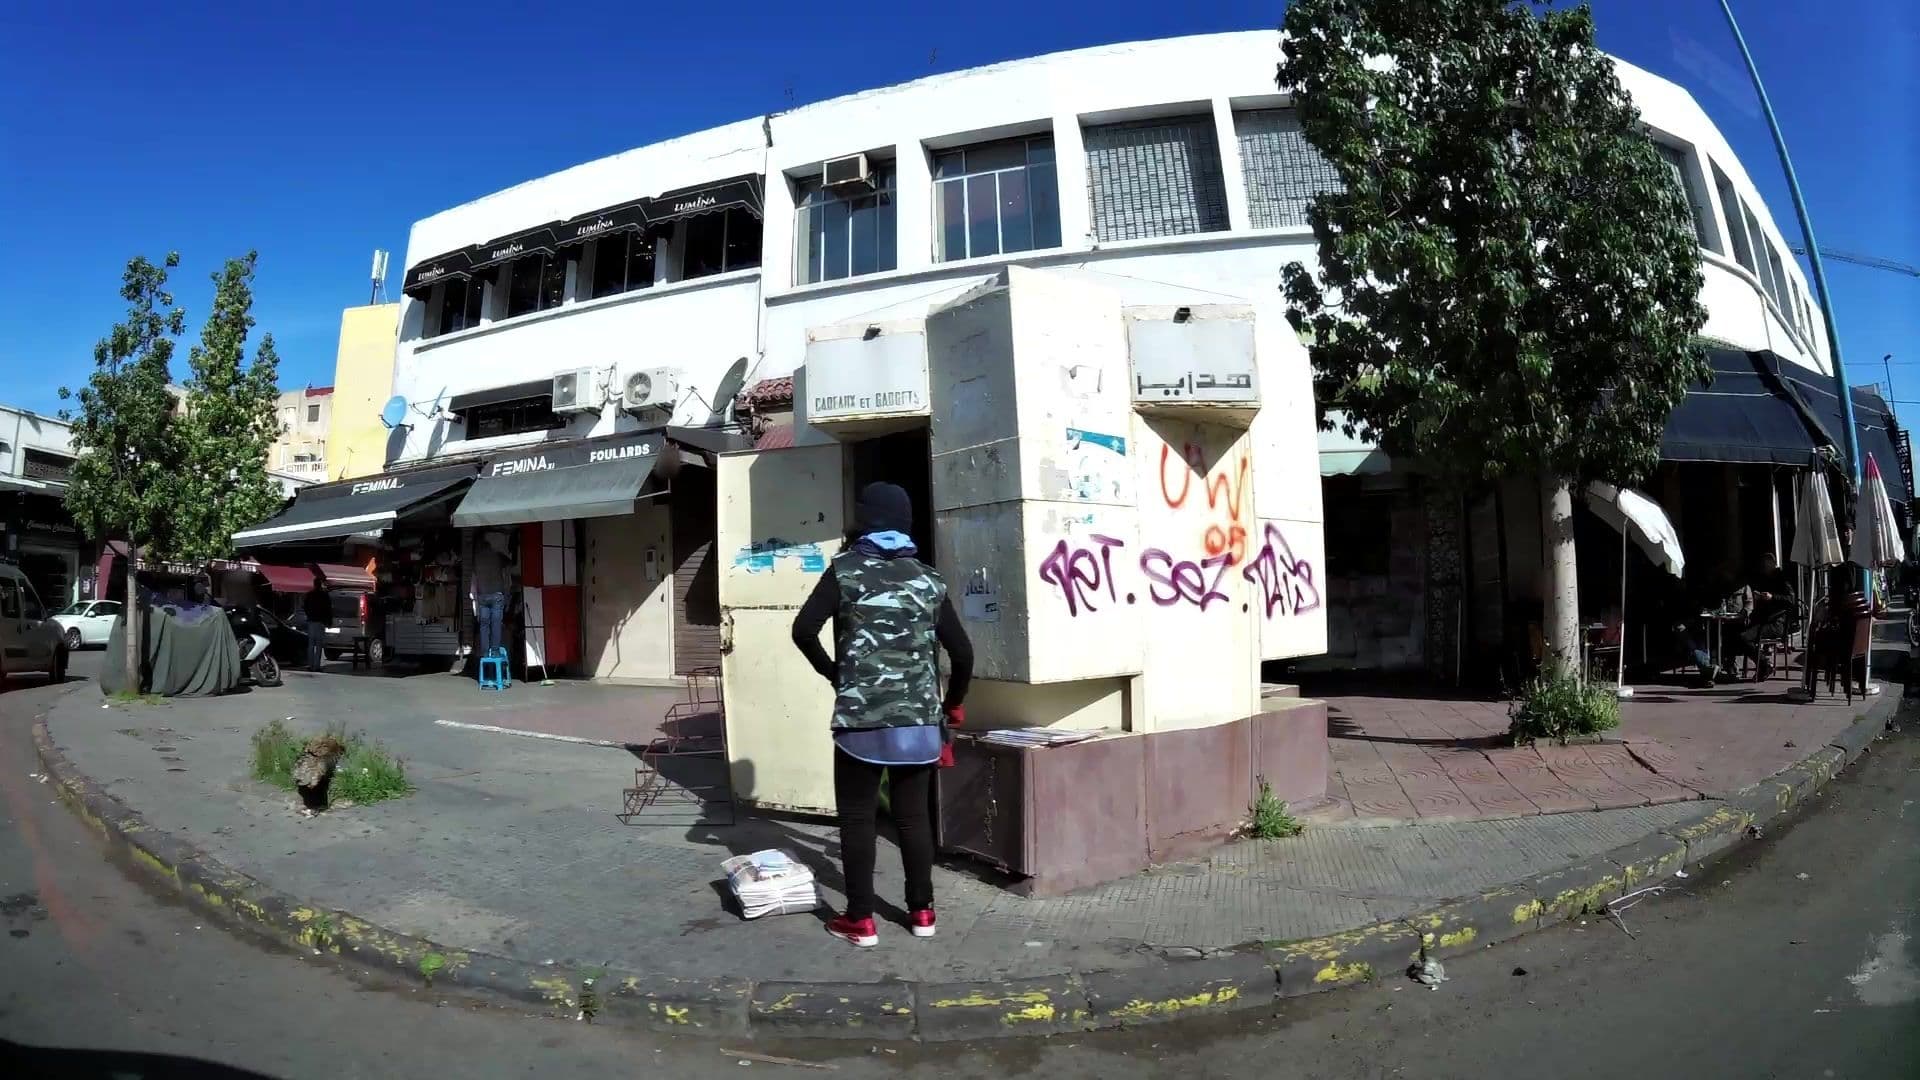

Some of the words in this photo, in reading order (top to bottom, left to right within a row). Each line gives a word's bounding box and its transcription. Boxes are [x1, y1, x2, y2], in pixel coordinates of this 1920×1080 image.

[860, 397, 871, 409] ET
[590, 443, 650, 463] FOULARDS
[491, 455, 547, 477] FEMINA
[351, 477, 399, 496] FEMINA
